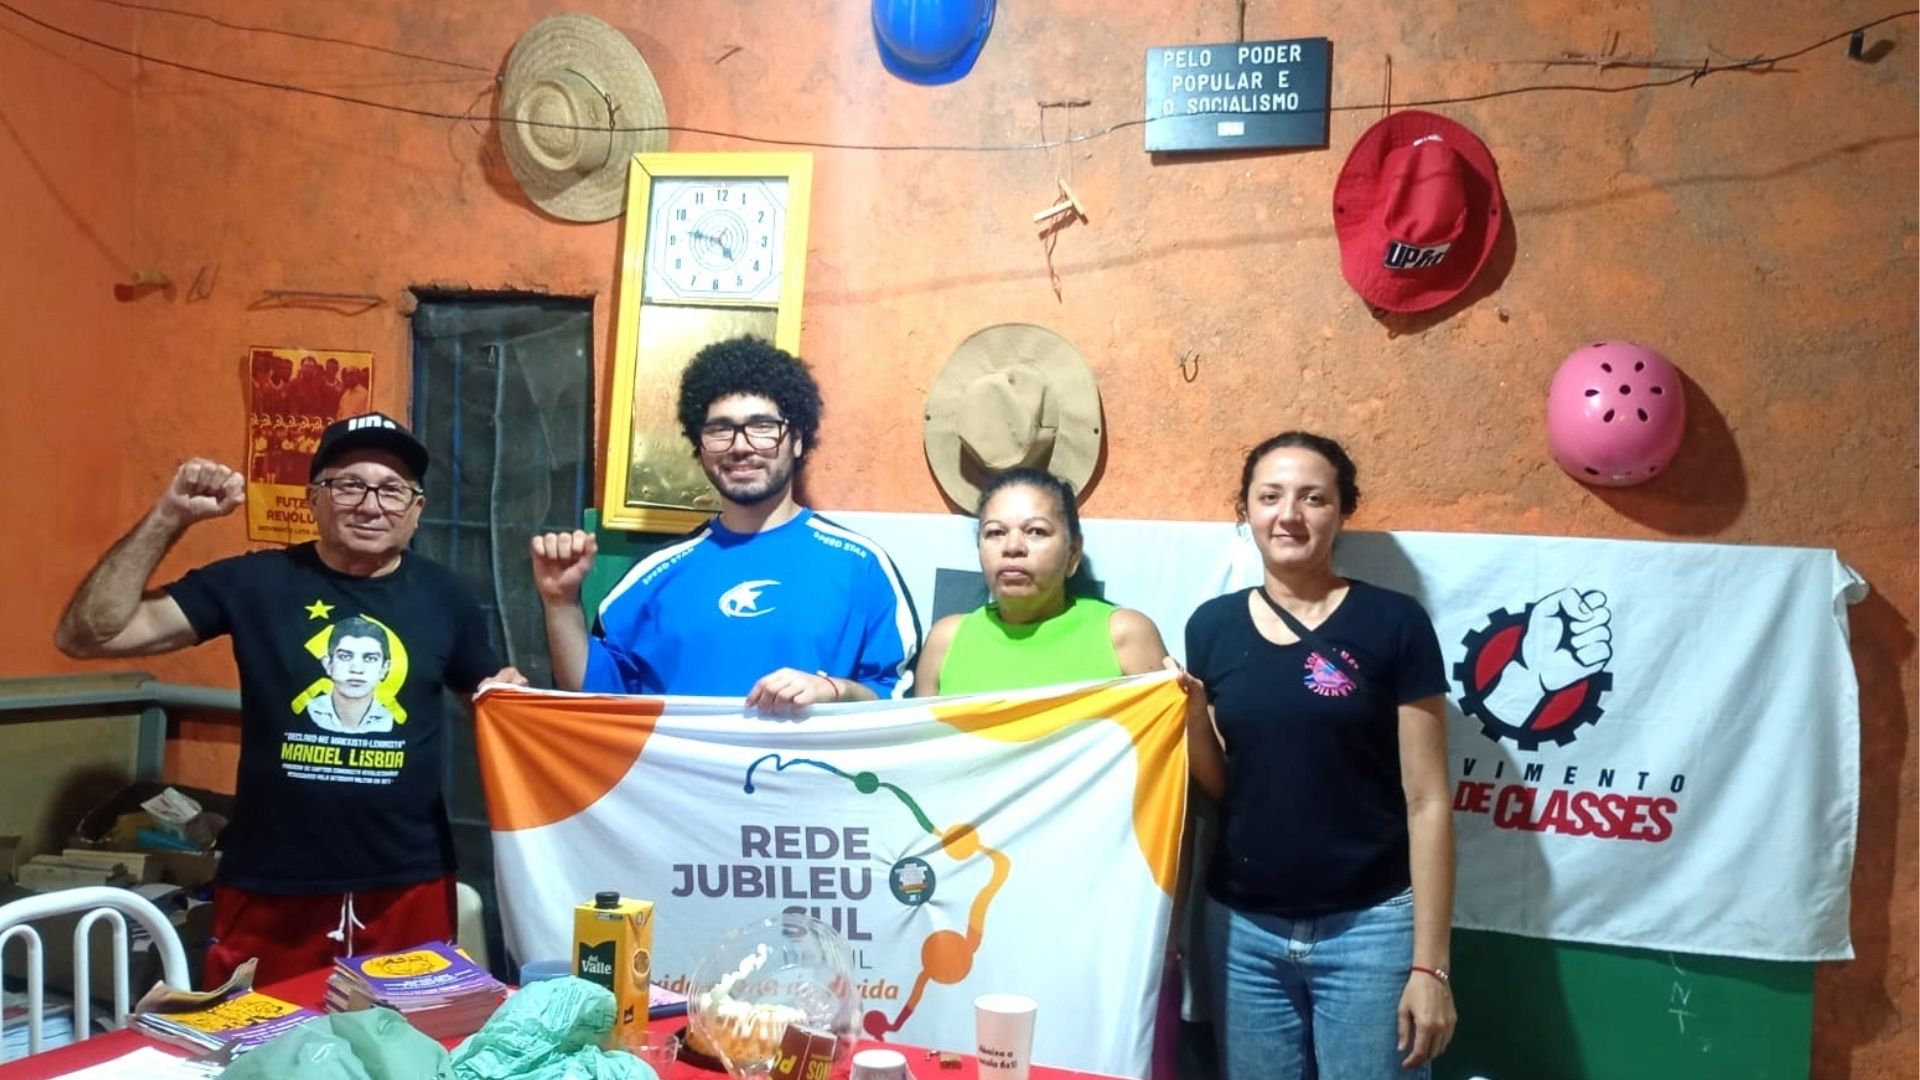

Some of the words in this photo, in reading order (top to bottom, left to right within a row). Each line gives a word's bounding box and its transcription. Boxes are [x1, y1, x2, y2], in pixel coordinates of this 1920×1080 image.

[1163, 49, 1211, 69] PELO
[1238, 44, 1302, 65] PODER
[1172, 70, 1263, 93] POPULAR
[1278, 70, 1290, 88] E
[1162, 100, 1175, 115] O
[1187, 92, 1299, 113] SOCIALISMO
[695, 192, 704, 205] 11
[717, 189, 729, 202] 12
[676, 209, 687, 221] 10
[758, 211, 765, 223] 2
[761, 236, 768, 248] 3
[753, 260, 760, 272] 4
[691, 275, 697, 286] 7
[712, 279, 719, 290] 6
[736, 275, 743, 286] 5
[267, 509, 316, 524] REVOLU
[281, 742, 343, 765] MANOEL
[1463, 758, 1686, 793] VIMENTO
[1452, 781, 1495, 814] DE
[1493, 784, 1678, 843] CLASSES
[740, 825, 871, 860] REDE
[671, 864, 872, 901] JUBILEU
[781, 906, 872, 941] SUL
[581, 960, 612, 975] Valle
